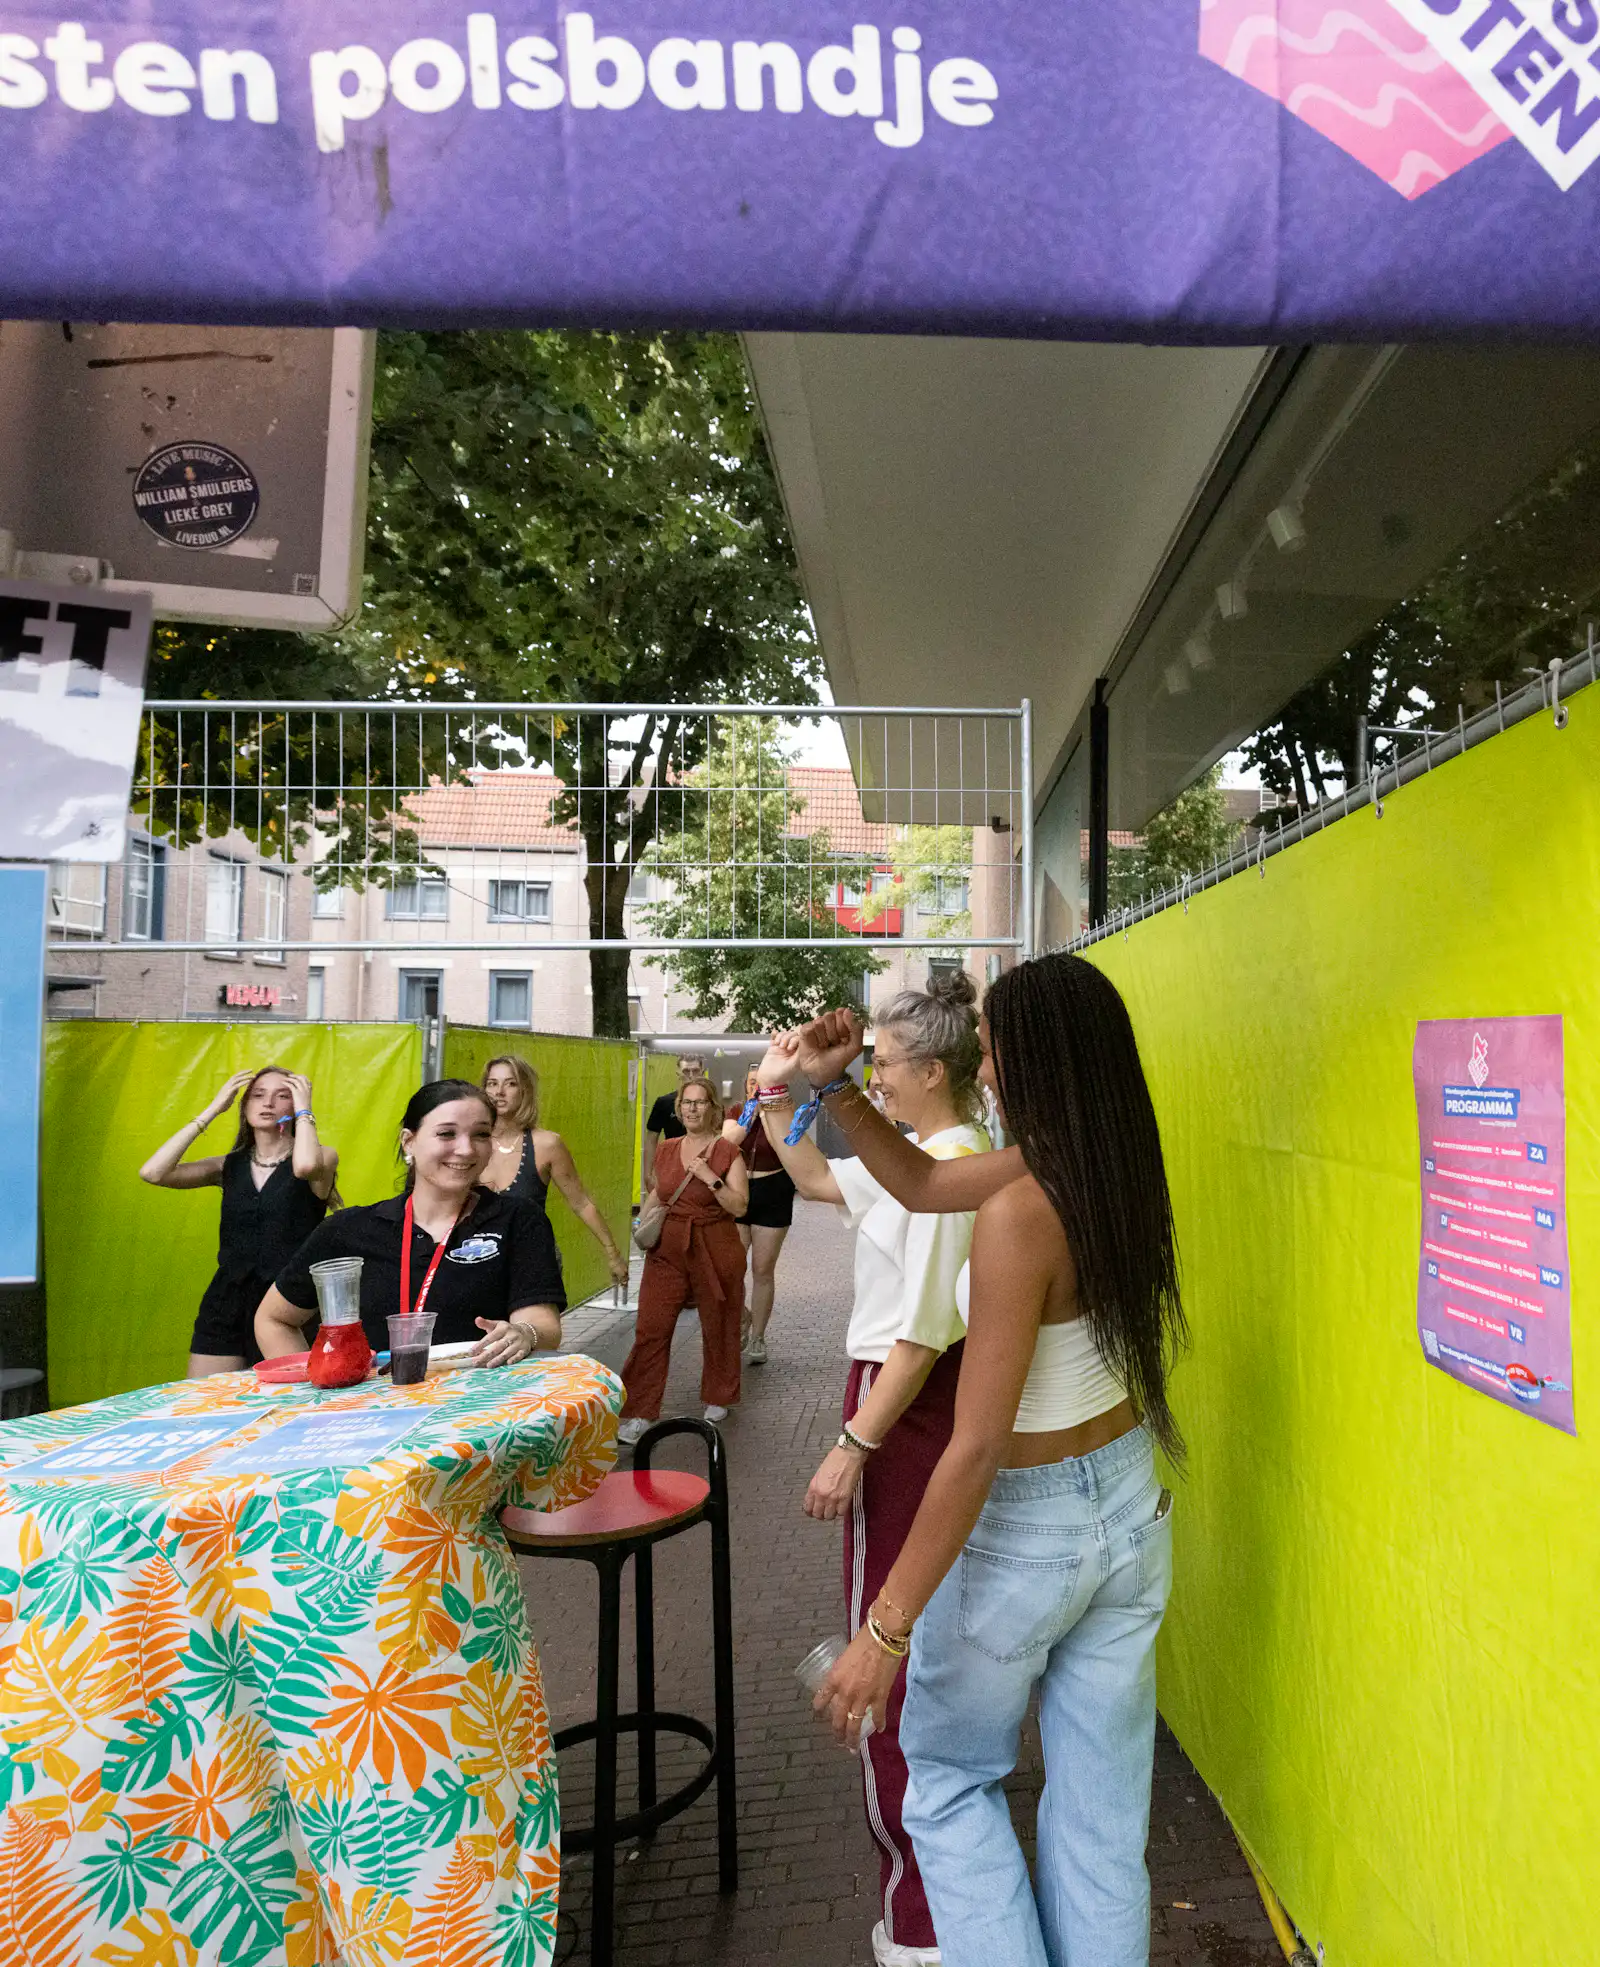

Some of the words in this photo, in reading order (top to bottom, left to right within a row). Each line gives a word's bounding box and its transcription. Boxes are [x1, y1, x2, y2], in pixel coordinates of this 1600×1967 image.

[309, 12, 999, 152] polsbandje
[134, 487, 187, 506] WILLIAM
[189, 478, 254, 498] SMULDERS
[164, 506, 200, 524] LIEKE
[201, 502, 233, 518] GREY
[1446, 1100, 1514, 1115] PROGRAMMA
[1530, 1147, 1544, 1160] ZA
[1536, 1211, 1552, 1227] MA
[1428, 1263, 1437, 1275] DO
[1541, 1269, 1560, 1285] WO
[1510, 1324, 1523, 1341] VR
[83, 1428, 230, 1450] CASH
[42, 1447, 194, 1468] ONLY
